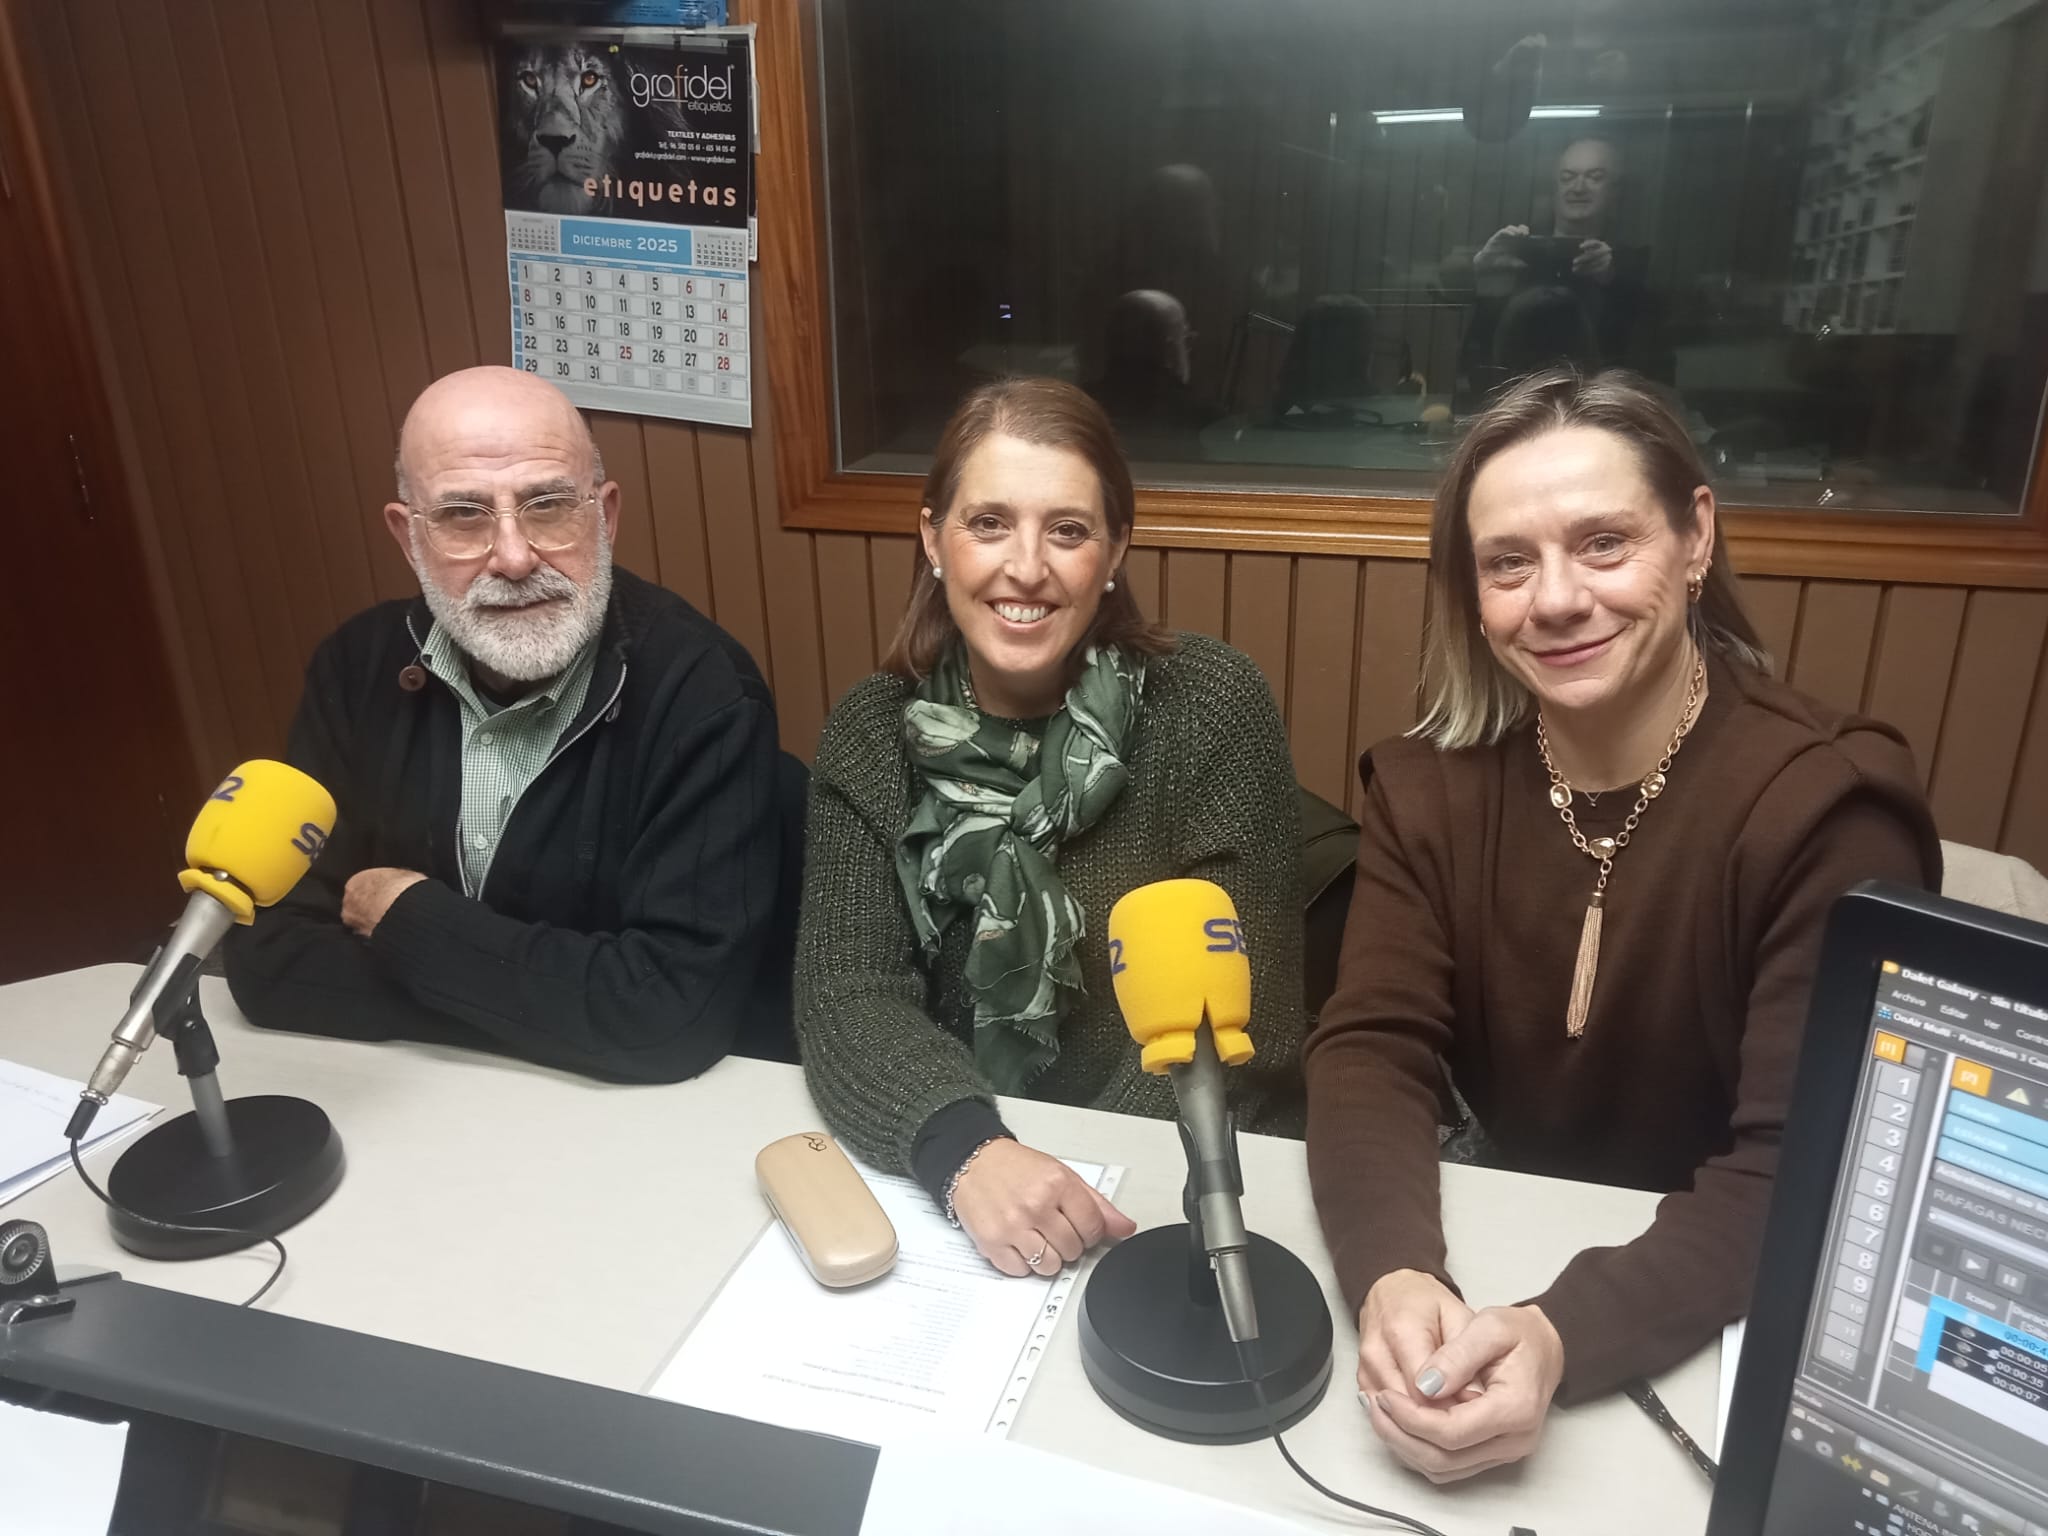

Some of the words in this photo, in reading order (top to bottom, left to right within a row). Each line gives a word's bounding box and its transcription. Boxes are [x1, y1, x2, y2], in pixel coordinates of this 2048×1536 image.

[688, 100, 732, 115] etiquetas
[667, 130, 694, 139] TEXTILES
[583, 173, 737, 208] etiquetas
[572, 235, 633, 249] DICIEMBRE
[637, 237, 678, 253] 2025
[524, 266, 529, 278] 1
[554, 268, 561, 281] 2
[586, 272, 592, 284] 3
[619, 274, 625, 288] 4
[652, 278, 659, 291] 5
[686, 281, 692, 293] 6
[719, 284, 725, 297] 7
[524, 289, 531, 302] 8
[555, 292, 562, 305] 9
[586, 296, 596, 309] 10
[620, 299, 627, 312] 11
[651, 302, 662, 315] 12
[685, 305, 695, 318] 13
[717, 309, 728, 322] 14
[524, 313, 534, 325] 15
[556, 316, 565, 329] 16
[588, 319, 597, 333] 17
[619, 323, 630, 336] 18
[653, 326, 662, 339] 19
[684, 329, 697, 342] 20
[718, 333, 728, 346] 21
[525, 336, 537, 349] 22
[556, 339, 568, 353] 23
[588, 343, 599, 356] 24
[620, 346, 632, 359] 25
[652, 350, 665, 363] 26
[685, 354, 697, 367] 27
[717, 357, 730, 370] 28
[525, 359, 537, 372] 29
[557, 363, 569, 376] 30
[590, 366, 600, 379] 31
[211, 776, 244, 802] 2
[1902, 968, 1935, 986] Dalet
[1936, 980, 1978, 1000] Galaxy
[1891, 990, 1926, 1007] Archivo
[1940, 1005, 1968, 1020] Editar
[1984, 1019, 2001, 1030] Ver
[1893, 1013, 1922, 1028] OnAir
[1899, 1078, 1911, 1095] 1
[1890, 1103, 1907, 1122] 2
[1885, 1129, 1900, 1146] 3
[1879, 1155, 1895, 1172] 4
[1874, 1179, 1889, 1196] 5
[1869, 1204, 1884, 1221] 6
[1933, 1189, 2007, 1224] RAFAGAS
[1864, 1228, 1880, 1244] 7
[1858, 1252, 1873, 1269] 8
[1853, 1276, 1868, 1293] 9
[1850, 1304, 1863, 1314] 10
[1845, 1328, 1855, 1337] 11
[1840, 1350, 1852, 1360] 12
[2001, 1346, 2047, 1373] 00:00:05
[1996, 1361, 2044, 1388] 00:00:35
[1992, 1376, 2040, 1402] 00:00:07
[1893, 1504, 1939, 1533] ANTENA
